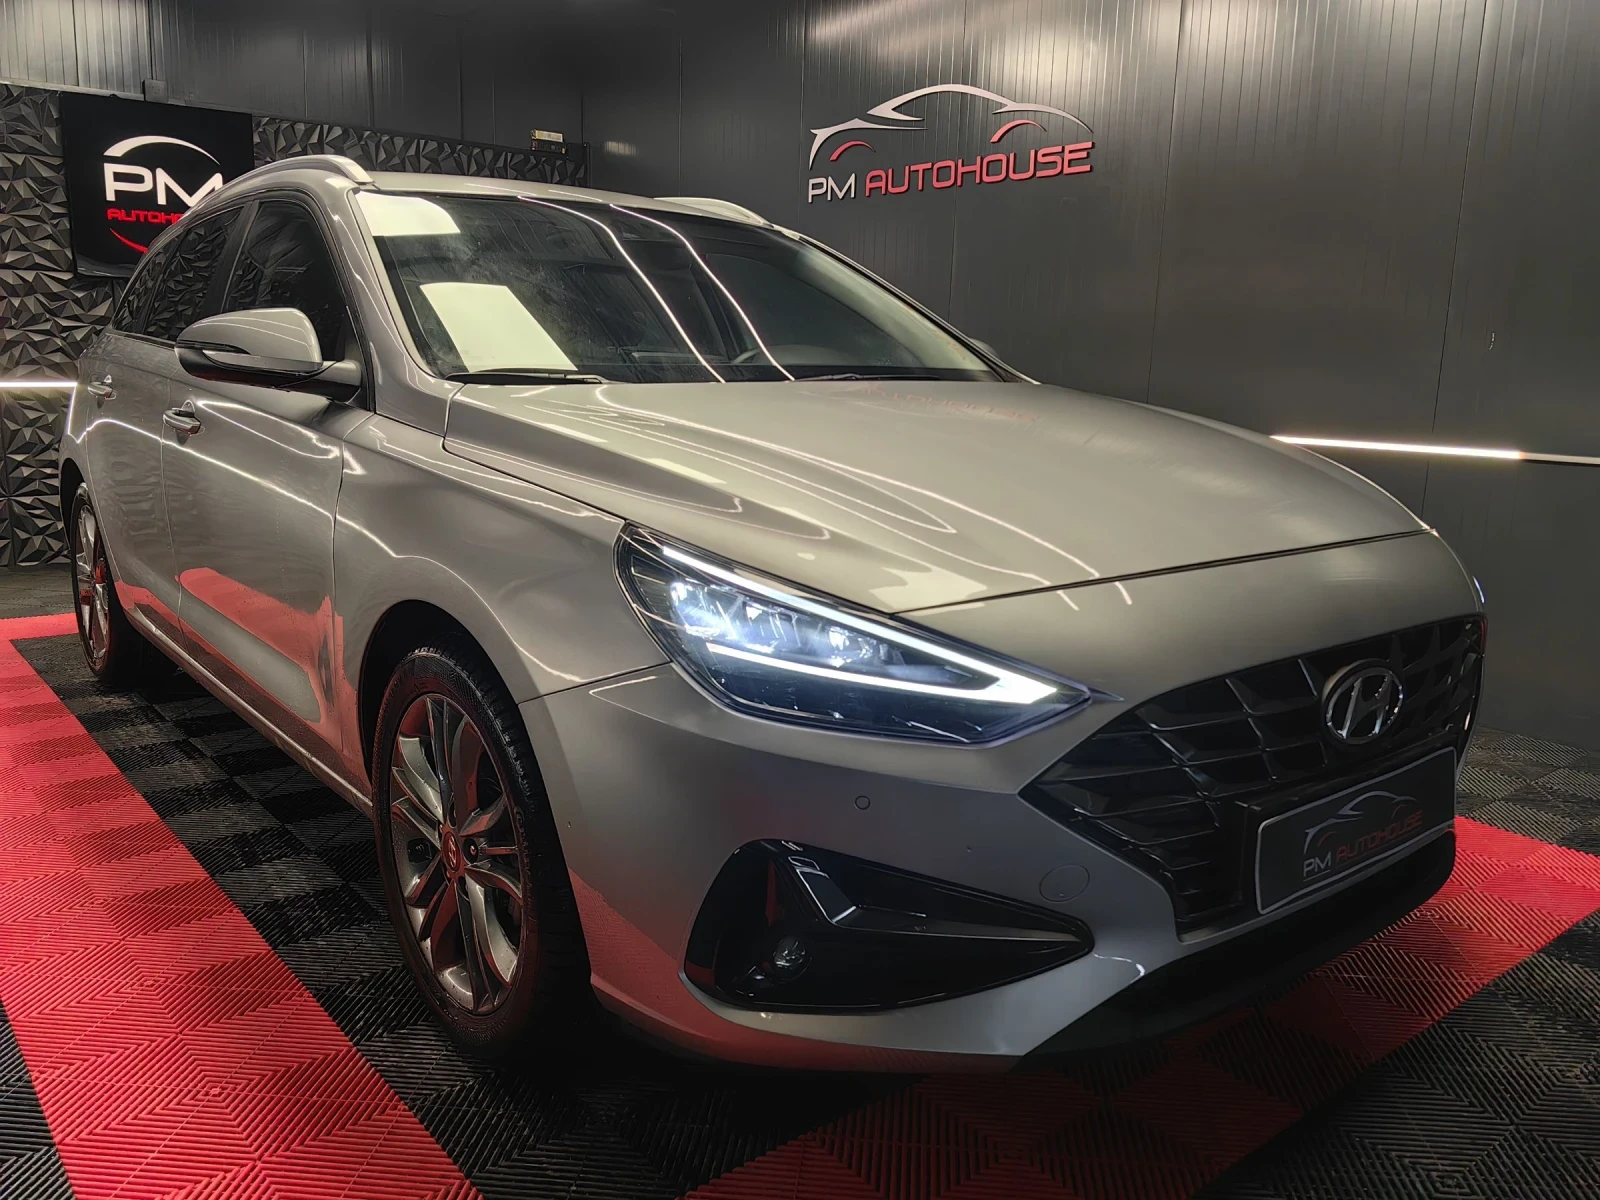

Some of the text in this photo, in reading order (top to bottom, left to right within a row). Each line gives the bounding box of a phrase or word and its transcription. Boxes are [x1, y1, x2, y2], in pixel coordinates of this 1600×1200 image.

[103, 162, 223, 207] PM
[808, 141, 1093, 203] PM AUTOHOUSE
[1303, 810, 1423, 877] PM AUTOHOUSE
